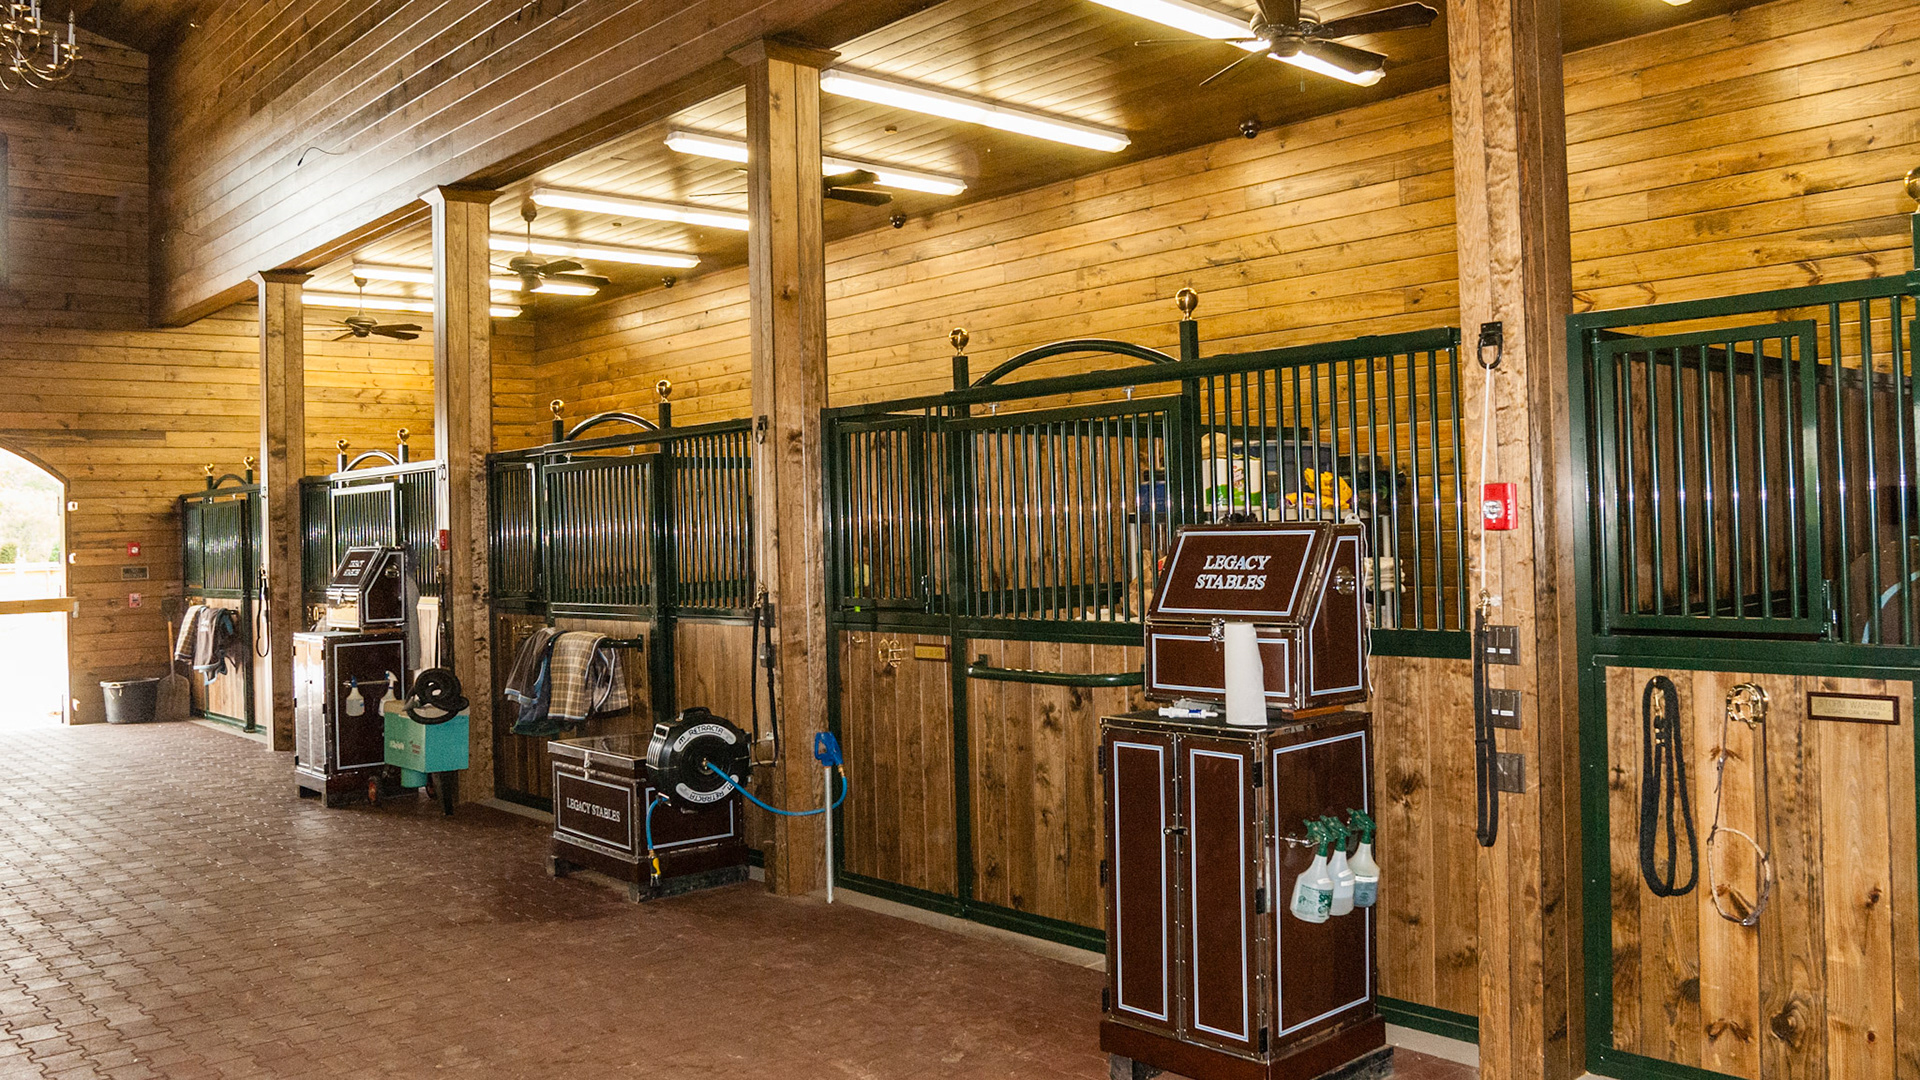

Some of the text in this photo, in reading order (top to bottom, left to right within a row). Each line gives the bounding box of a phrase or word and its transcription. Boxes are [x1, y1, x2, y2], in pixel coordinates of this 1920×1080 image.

[1203, 555, 1271, 570] LEGACY
[1194, 574, 1267, 590] STABLES
[688, 725, 724, 736] RETRACTA
[566, 797, 621, 823] LEGACY STABLES
